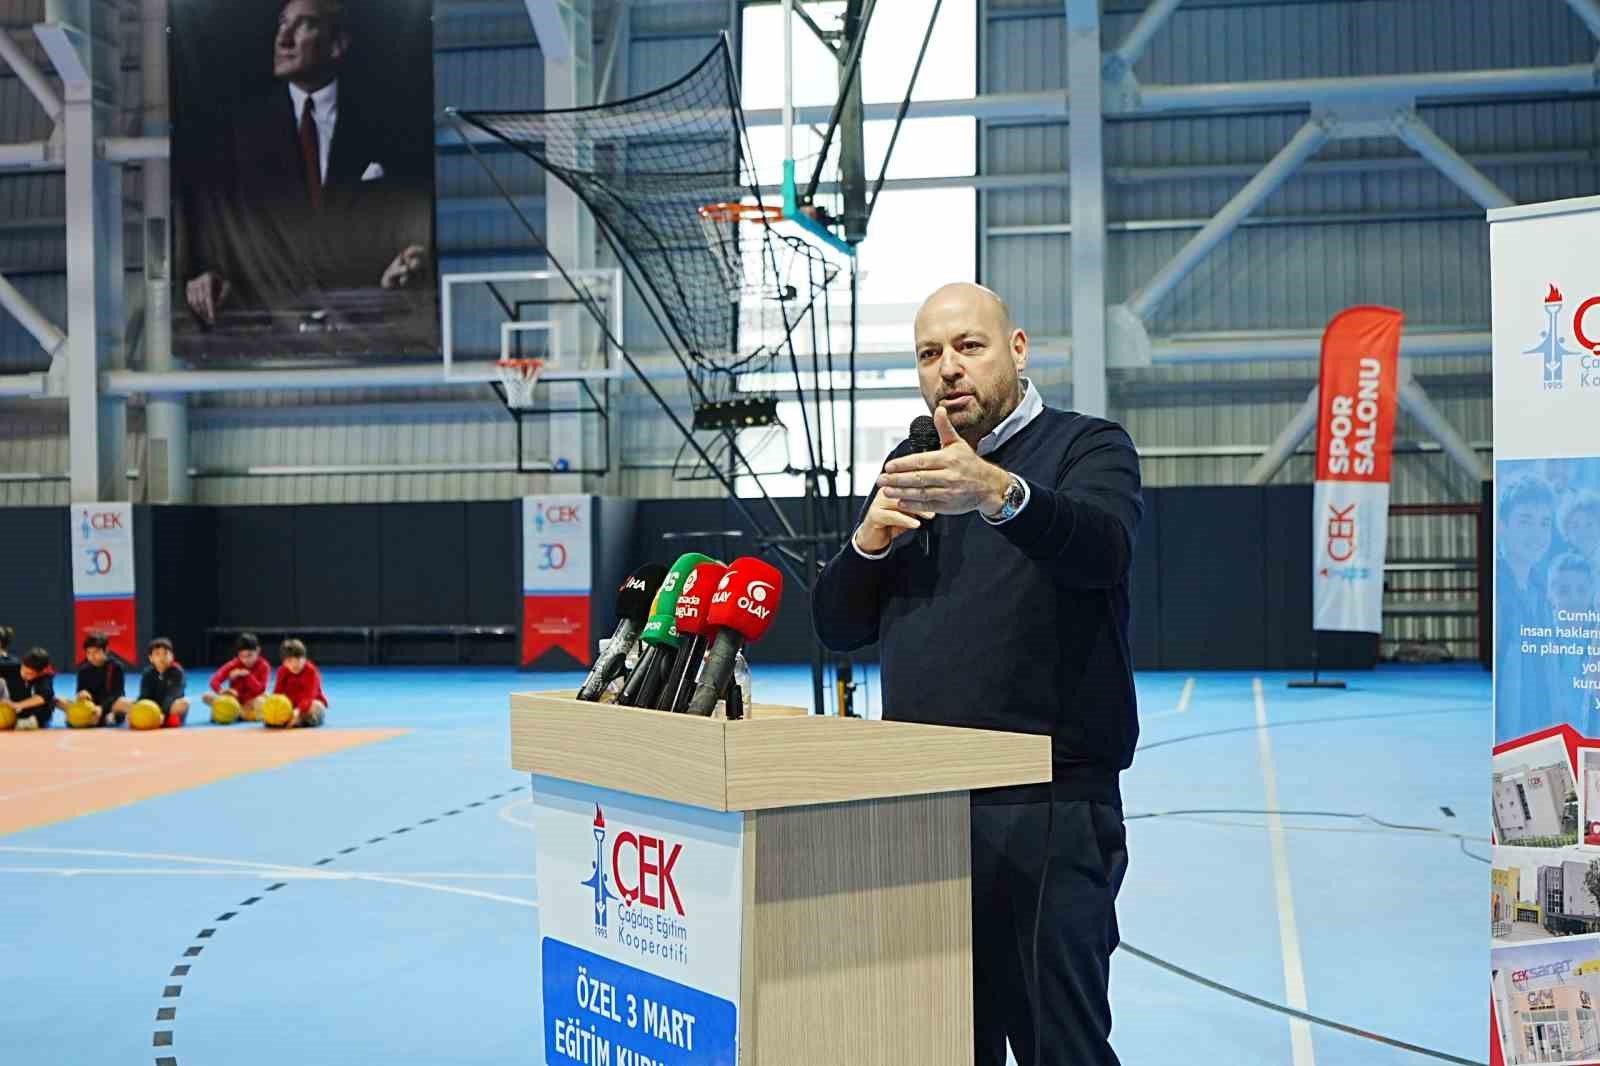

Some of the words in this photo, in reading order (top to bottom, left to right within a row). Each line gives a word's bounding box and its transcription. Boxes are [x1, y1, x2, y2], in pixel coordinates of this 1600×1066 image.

[1353, 357, 1381, 475] SALONU
[1328, 394, 1354, 475] SPOR
[84, 549, 112, 576] 30
[537, 543, 566, 571] 30
[677, 595, 700, 605] sada
[711, 591, 731, 603] OLAY
[737, 595, 770, 619] OLAY
[1520, 624, 1552, 638] insan
[1521, 641, 1537, 654] ön
[1540, 642, 1584, 657] planda
[612, 831, 685, 917] ÇEK
[618, 903, 654, 935] Çağdaş
[656, 914, 687, 941] Eğitim
[618, 926, 687, 964] Kooperatifi
[576, 965, 622, 1023] ÖZEL
[626, 994, 638, 1029] 3
[643, 998, 696, 1051] MART
[555, 1017, 610, 1066] EĞİTİM
[616, 1045, 664, 1066] KU
